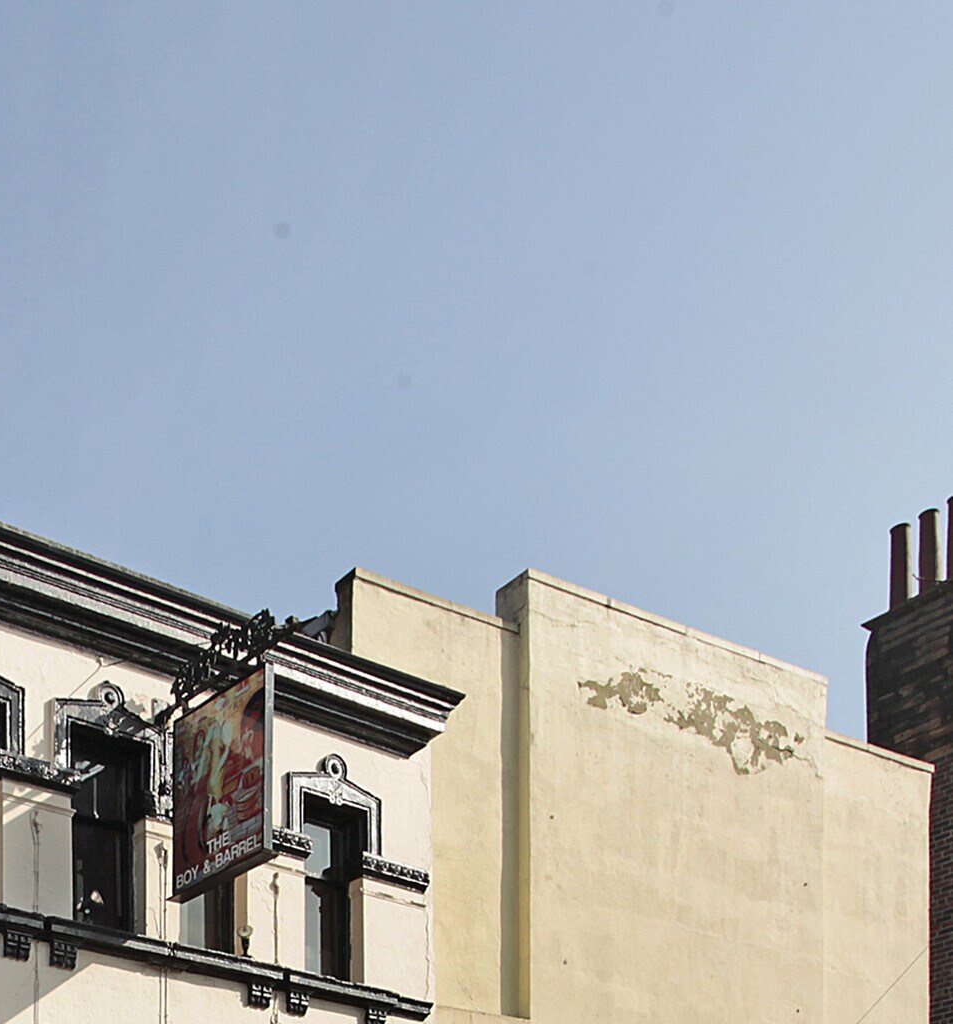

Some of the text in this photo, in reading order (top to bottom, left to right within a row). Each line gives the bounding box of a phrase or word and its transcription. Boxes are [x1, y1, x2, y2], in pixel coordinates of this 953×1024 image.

[207, 831, 230, 854] THE
[176, 835, 261, 889] BOY & BARREL
